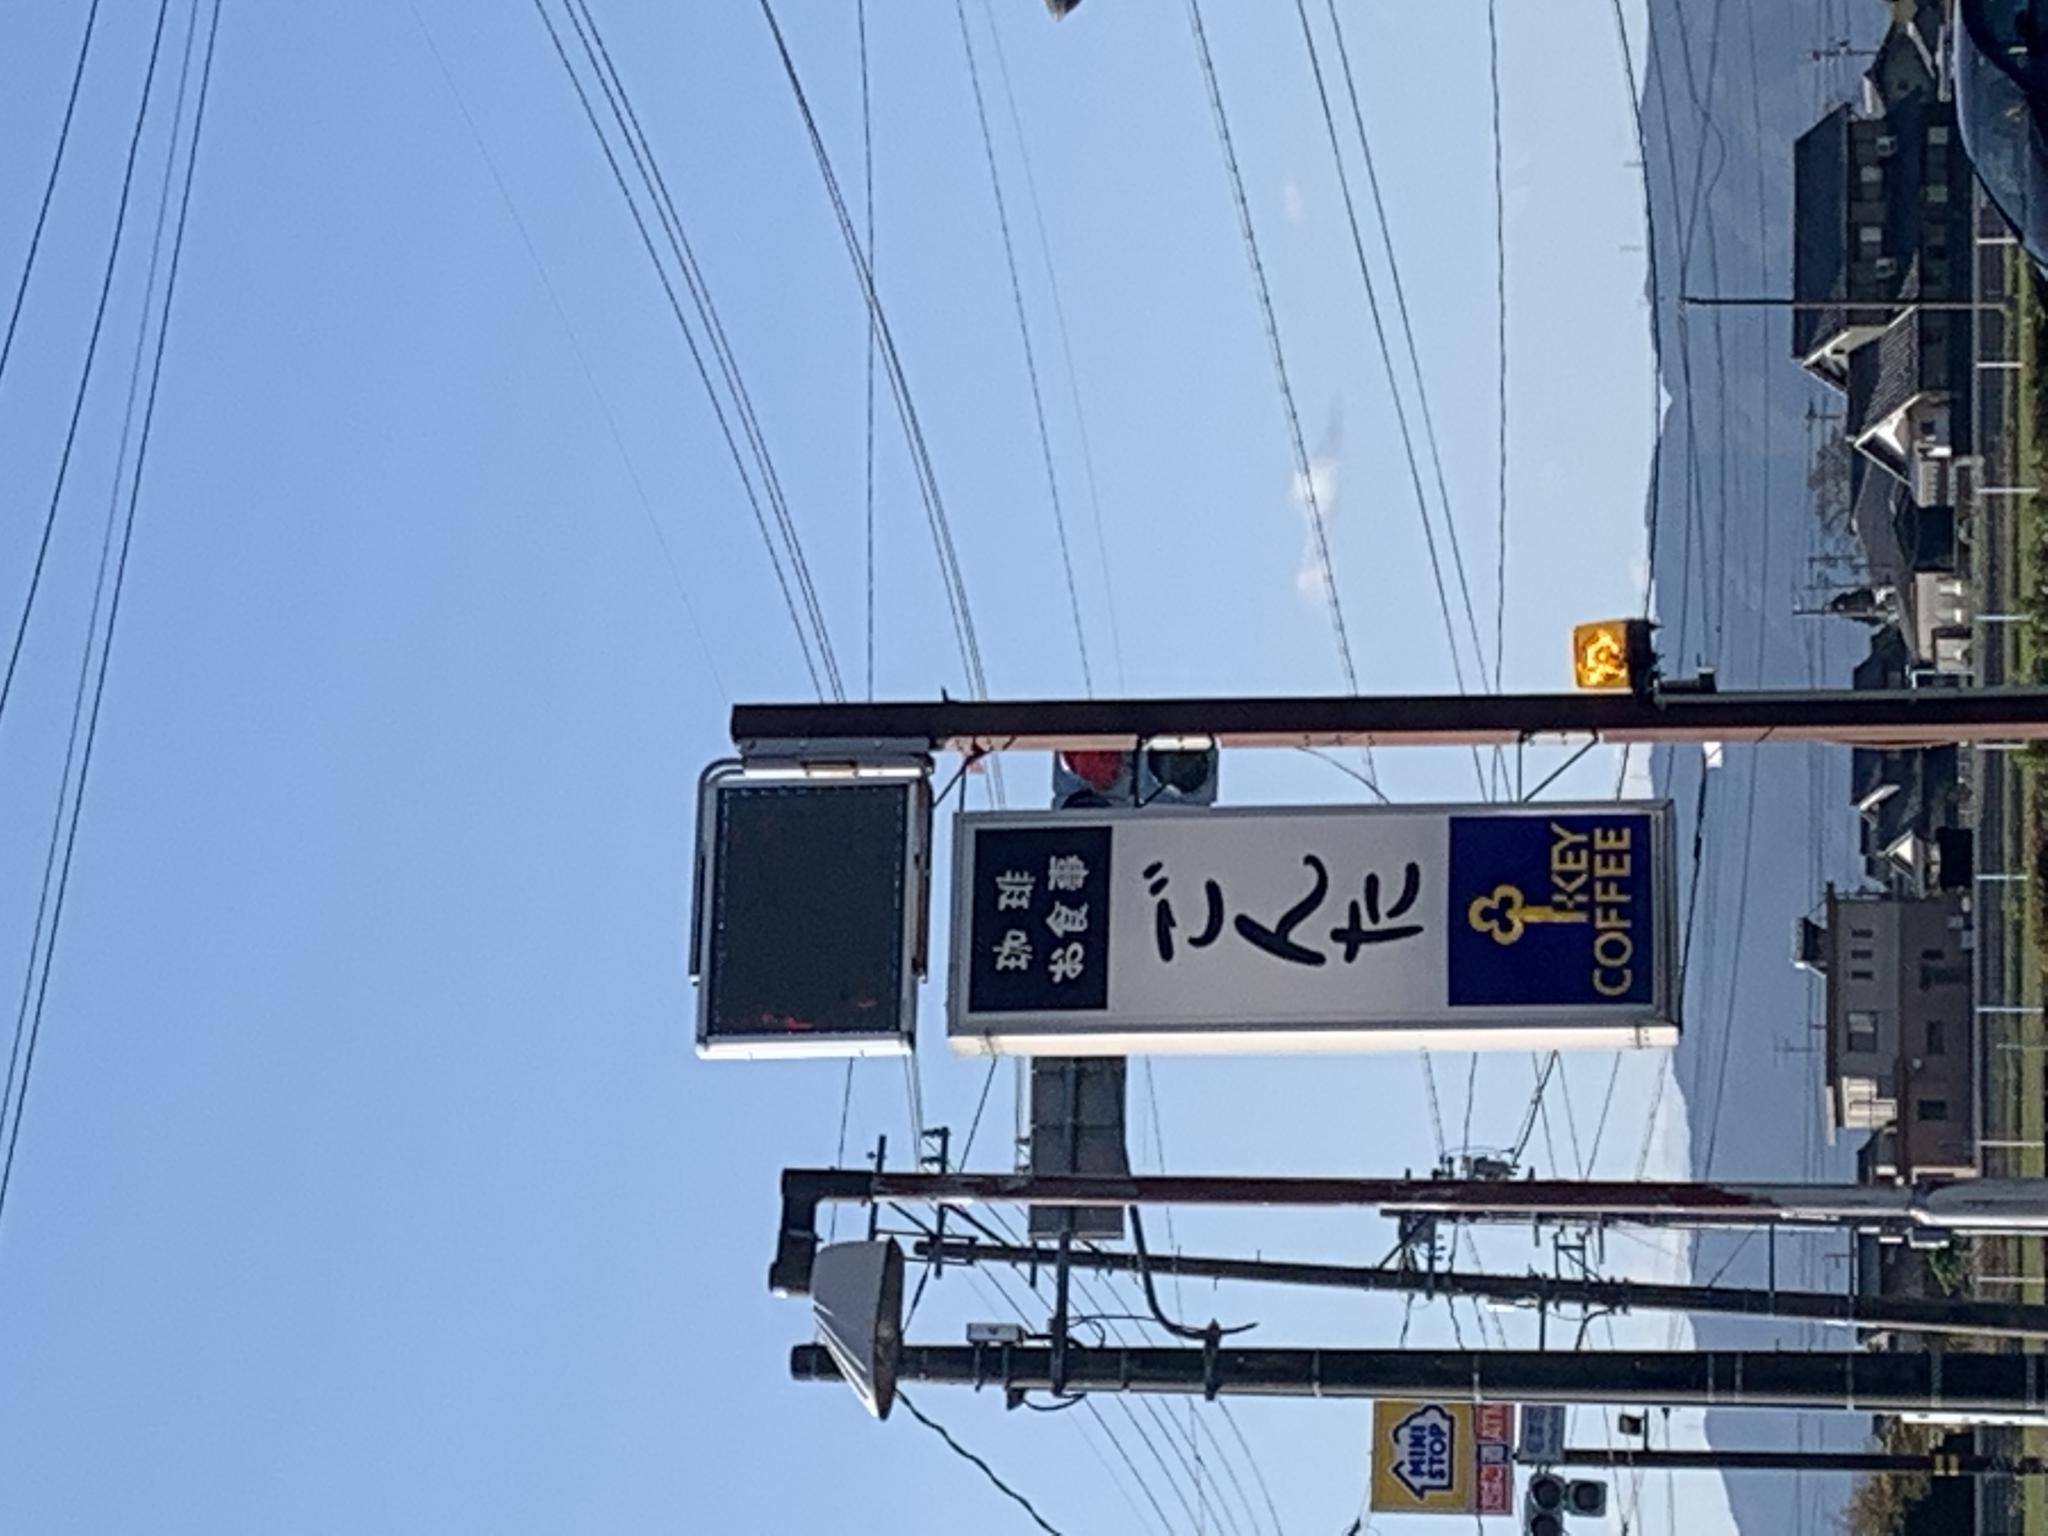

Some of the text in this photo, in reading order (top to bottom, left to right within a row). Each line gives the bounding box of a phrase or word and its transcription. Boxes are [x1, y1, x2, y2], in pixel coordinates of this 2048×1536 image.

[1142, 853, 1424, 966] ごんた
[1550, 821, 1589, 903] KEY
[1592, 826, 1633, 997] COFFEE
[992, 869, 1035, 971] 珈琲
[1045, 854, 1090, 983] お食事
[1409, 1424, 1427, 1478] MINI
[1427, 1422, 1447, 1480] STOP
